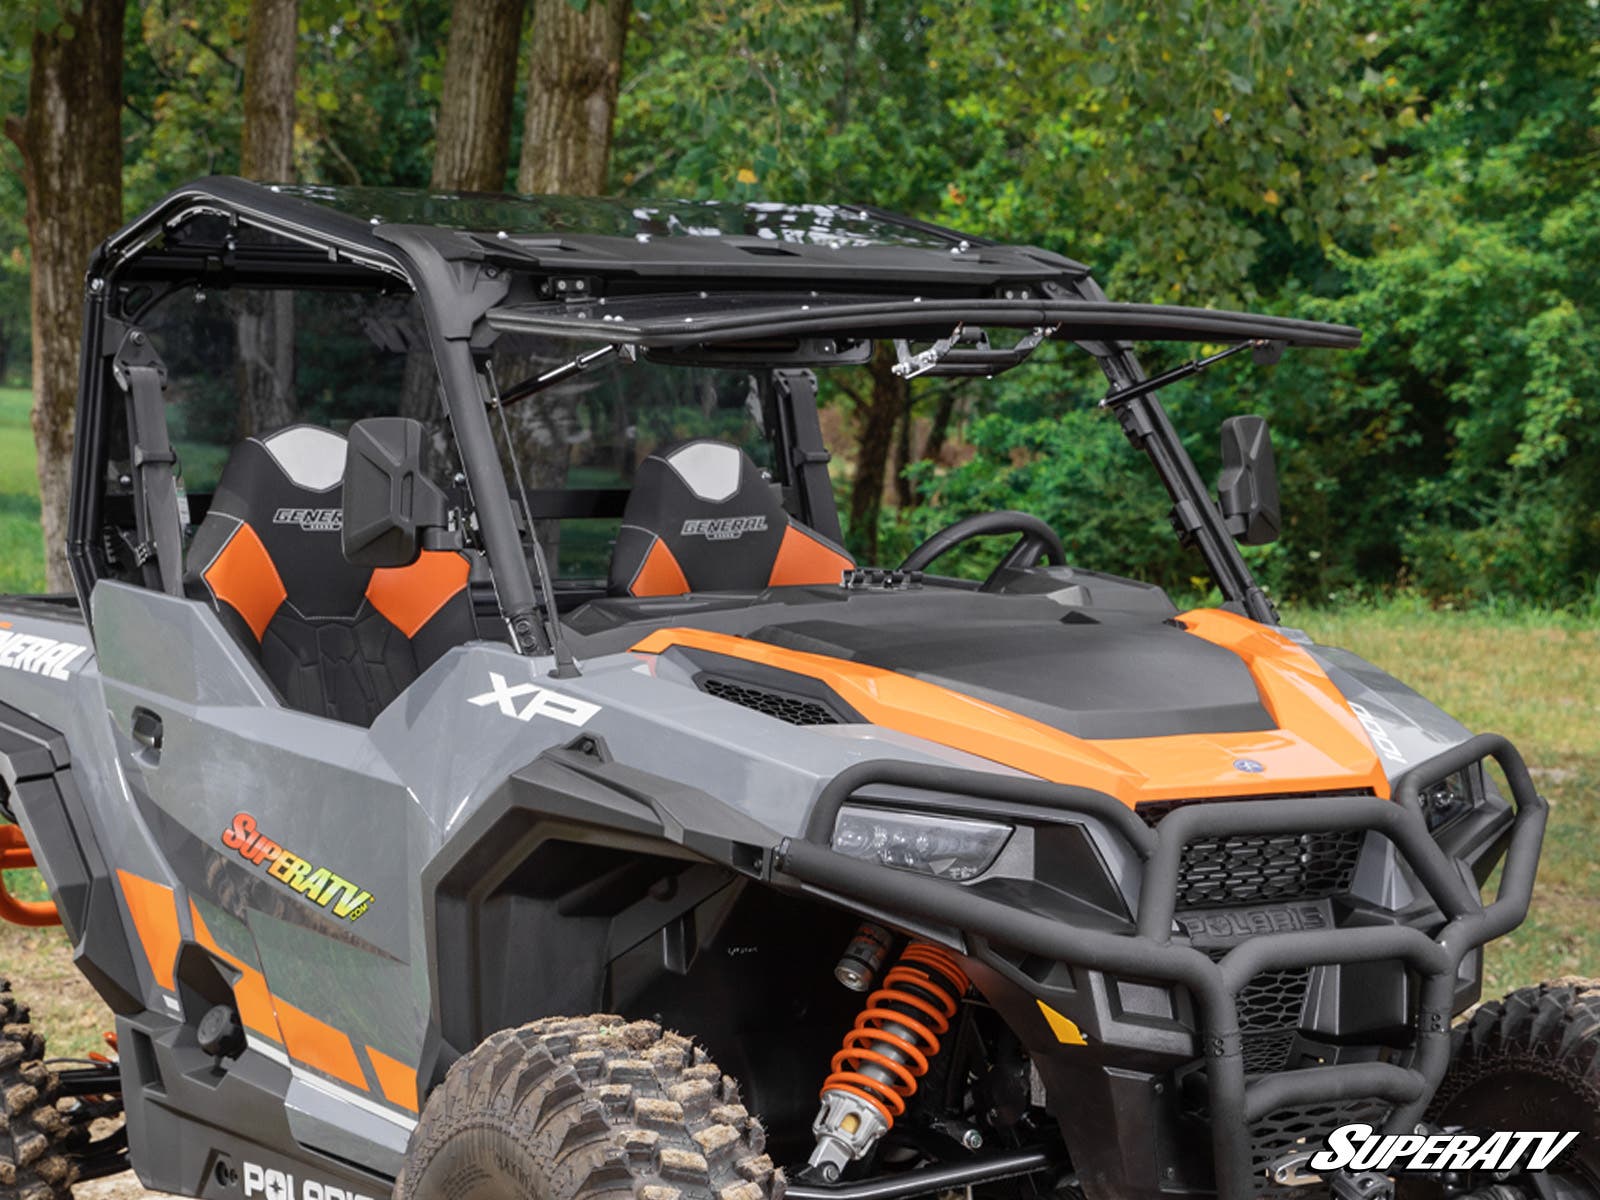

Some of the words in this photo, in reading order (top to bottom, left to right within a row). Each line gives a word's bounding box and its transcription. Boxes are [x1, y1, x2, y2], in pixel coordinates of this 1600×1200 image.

[273, 508, 343, 524] GENER
[681, 516, 768, 536] GENERAL
[466, 671, 602, 727] XP
[221, 812, 372, 919] SUPERATV
[1177, 905, 1327, 938] POLARIS
[243, 1161, 376, 1200] POLA
